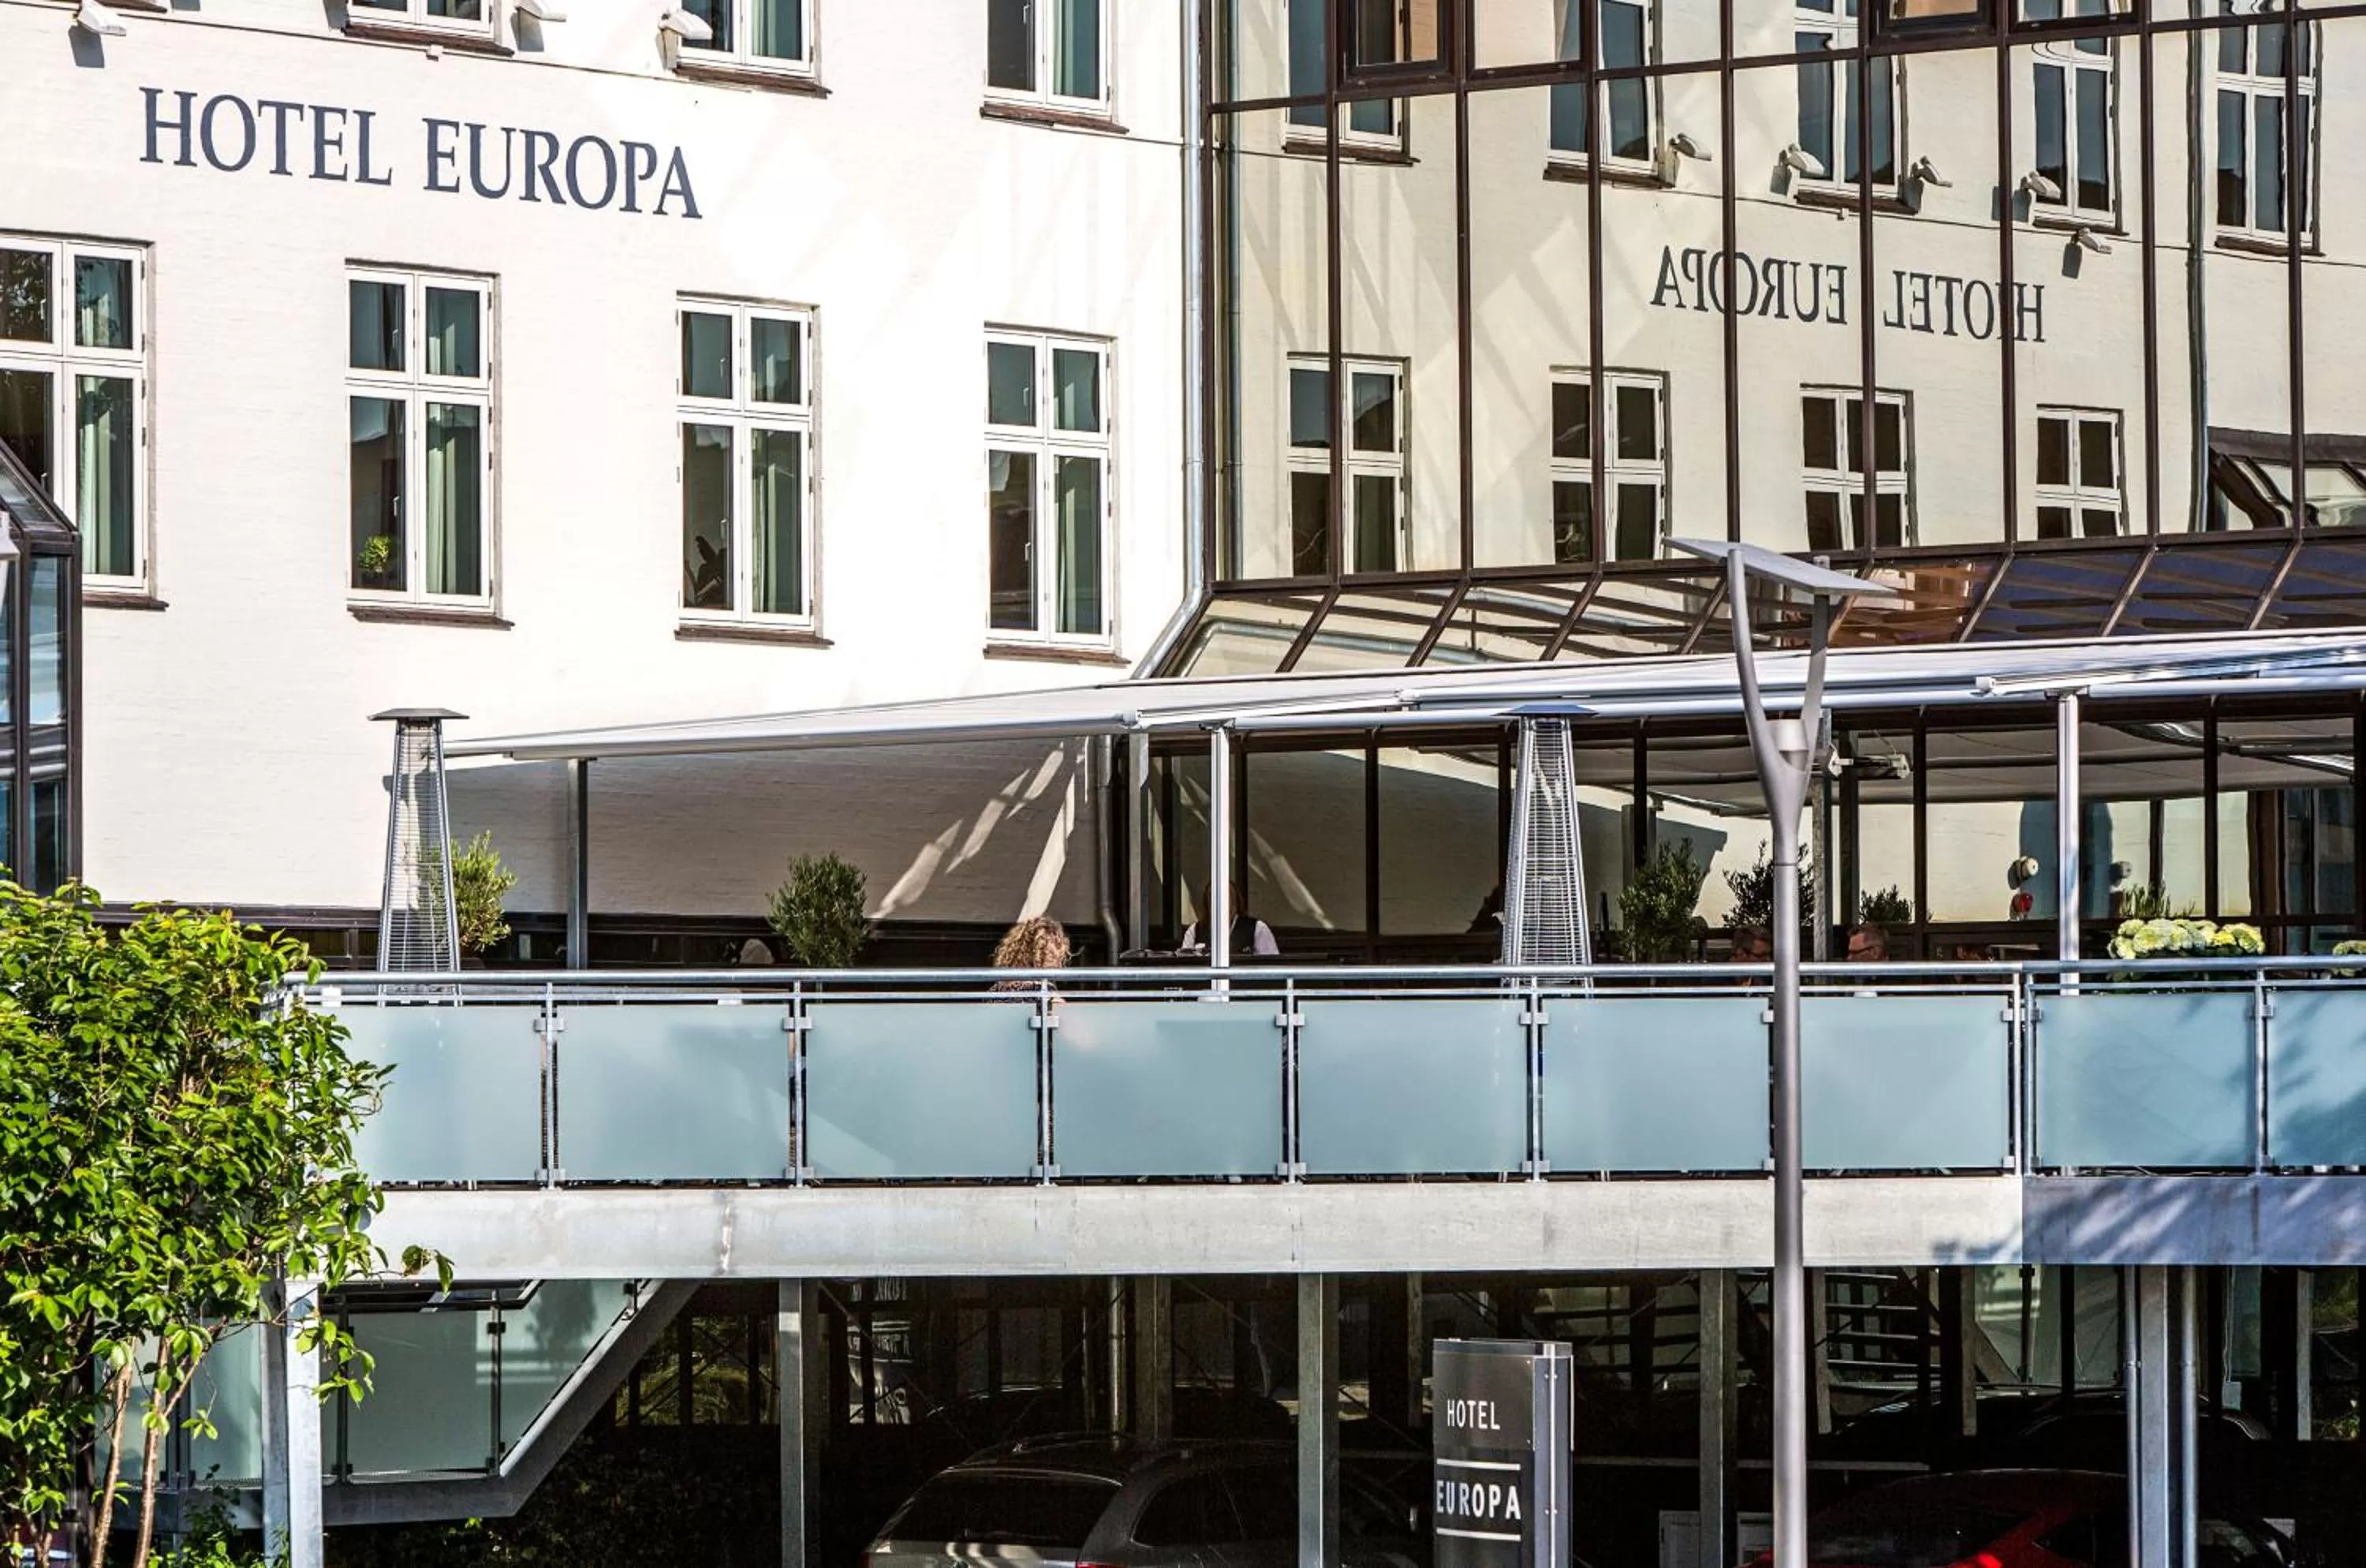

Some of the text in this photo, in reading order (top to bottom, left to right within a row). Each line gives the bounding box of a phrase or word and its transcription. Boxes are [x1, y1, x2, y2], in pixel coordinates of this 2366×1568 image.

[138, 86, 702, 219] HOTEL EUROPA
[1446, 1399, 1501, 1430] HOTEL
[1436, 1480, 1521, 1520] EUROPA
